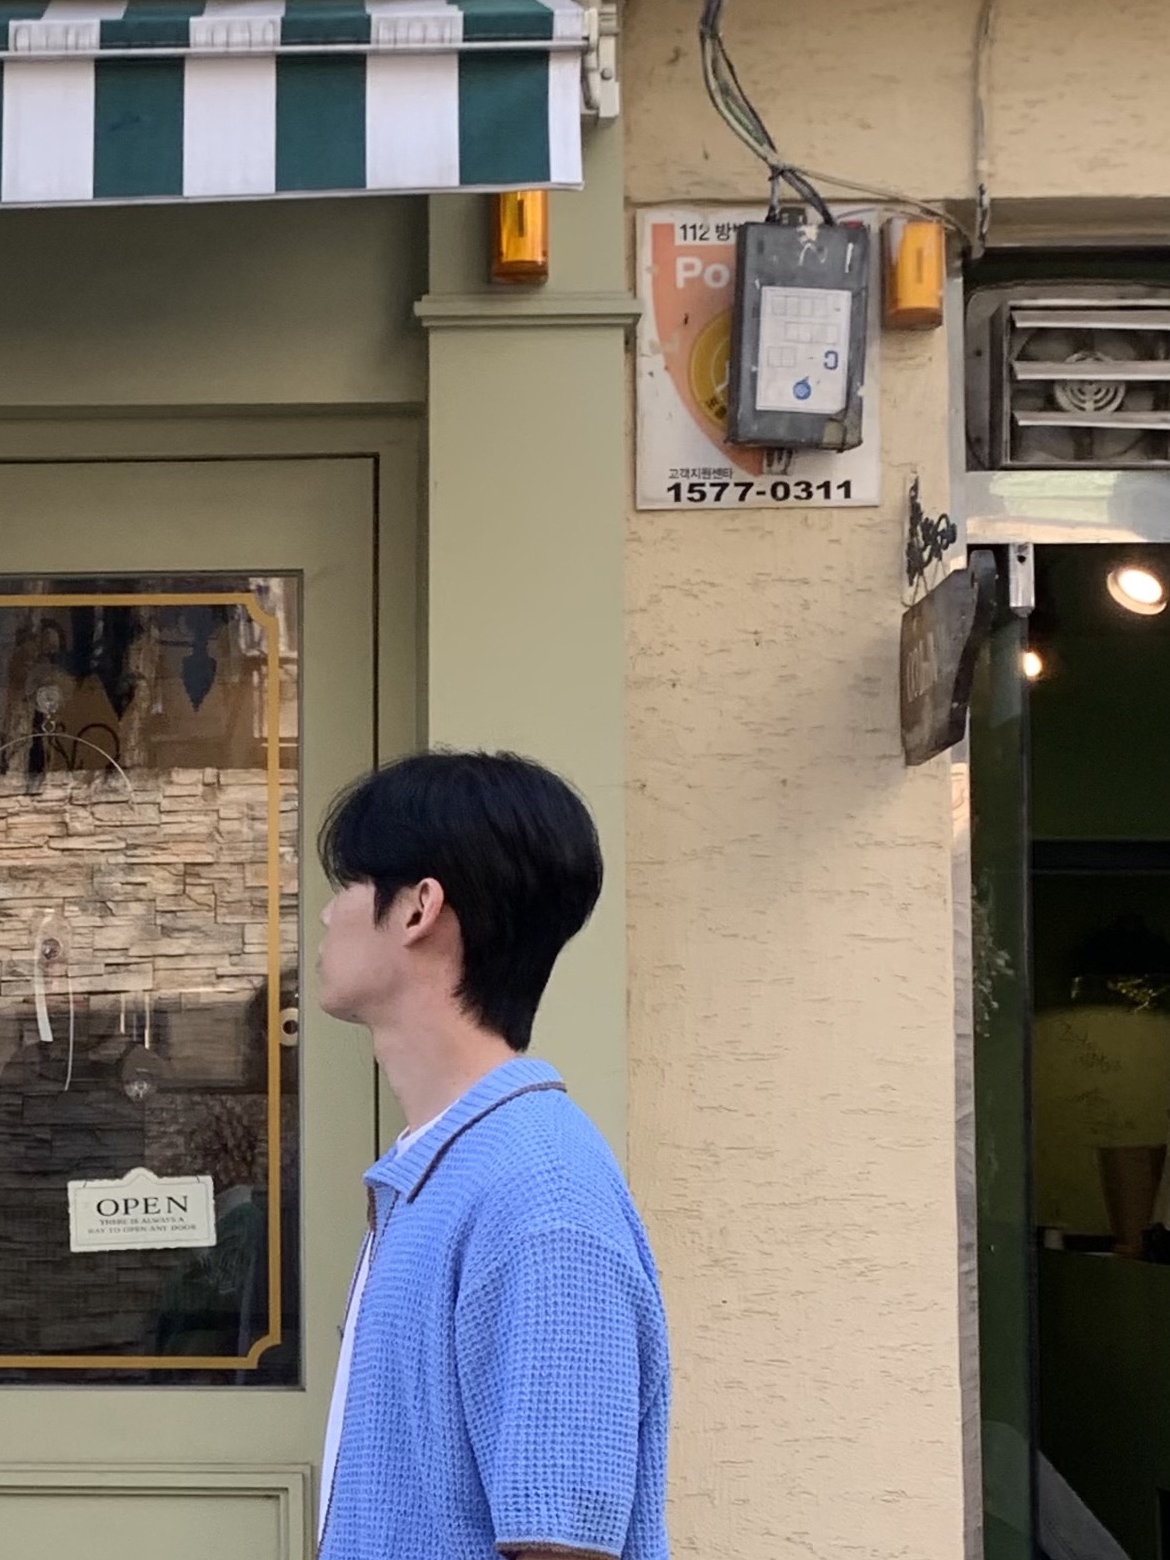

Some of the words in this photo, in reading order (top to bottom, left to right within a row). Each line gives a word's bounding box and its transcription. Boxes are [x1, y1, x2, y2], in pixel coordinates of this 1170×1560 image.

[679, 223, 710, 241] 112
[666, 479, 852, 503] 1577-0311
[96, 1195, 189, 1217] OPEN
